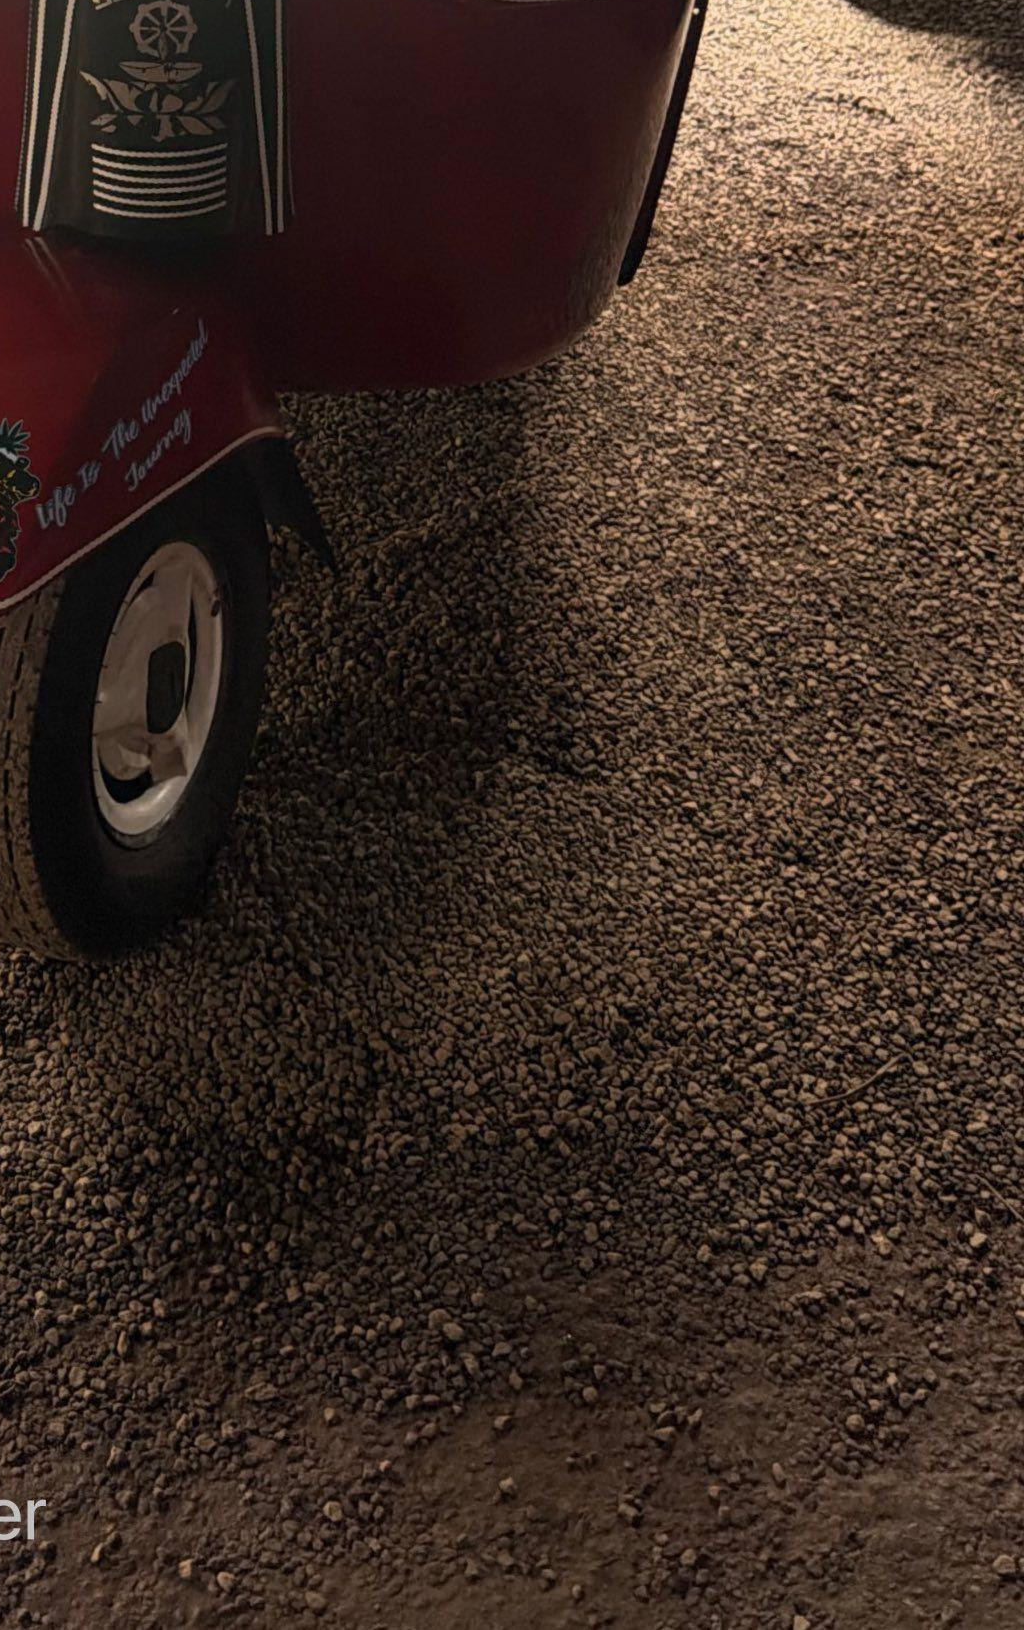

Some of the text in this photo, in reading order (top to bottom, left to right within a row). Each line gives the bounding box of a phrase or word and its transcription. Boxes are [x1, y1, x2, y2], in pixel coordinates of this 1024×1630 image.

[36, 483, 75, 530] Life
[102, 422, 139, 460] The
[141, 319, 209, 427] Unexpected
[124, 407, 192, 492] Journey
